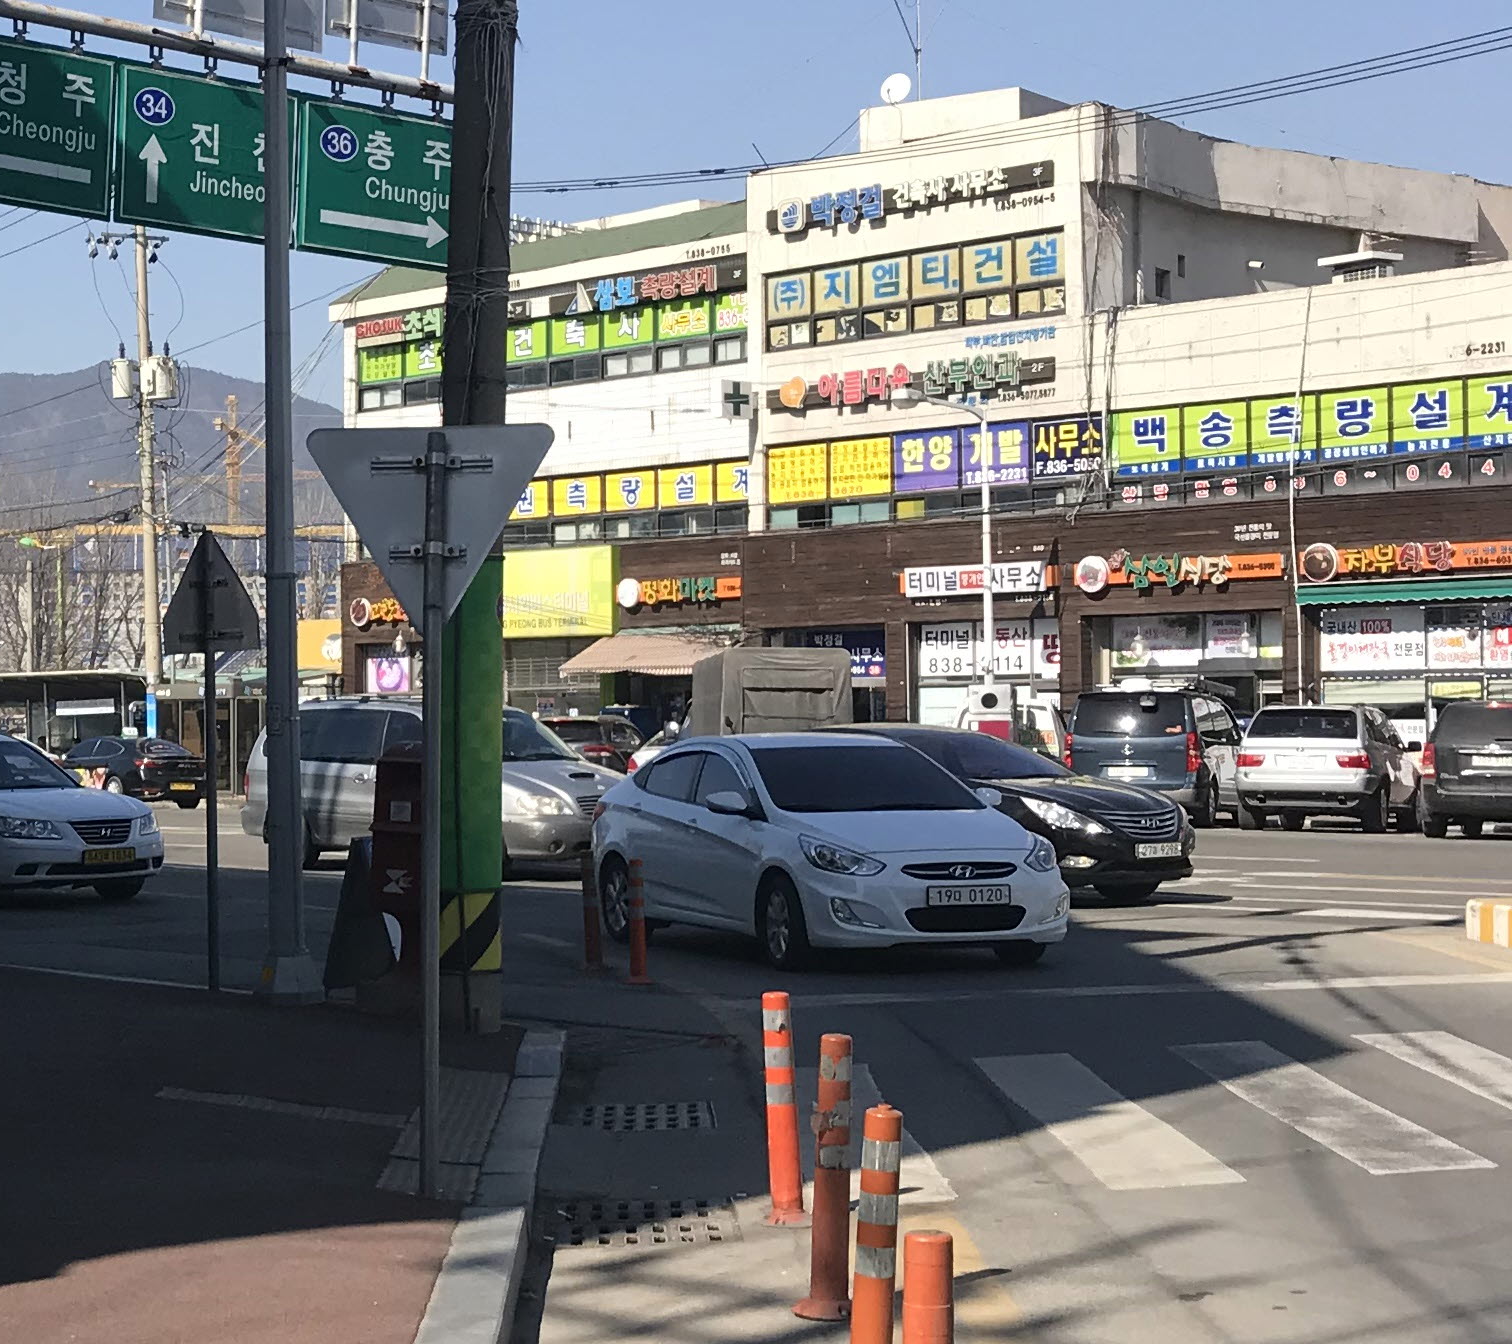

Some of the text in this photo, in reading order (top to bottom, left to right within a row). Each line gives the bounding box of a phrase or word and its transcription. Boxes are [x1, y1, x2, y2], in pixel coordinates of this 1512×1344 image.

[141, 93, 169, 118] 34
[327, 131, 353, 154] 36
[364, 130, 451, 181] 충주
[189, 170, 265, 205] Jincheo
[365, 177, 450, 212] Chungju
[892, 176, 946, 209] 건축사
[951, 166, 1008, 198] 사무소
[640, 265, 717, 301] 측량설계
[662, 309, 708, 336] 사무소
[923, 351, 1022, 395] 산부인과
[1031, 362, 1045, 373] 2F
[901, 434, 953, 473] 한양
[1035, 423, 1101, 459] 사무소
[908, 571, 957, 593] 터미널
[992, 566, 1041, 588] 사무소
[925, 629, 970, 650] 터미널
[1326, 620, 1391, 635] 국내산 100%
[1394, 642, 1424, 657] 전문점
[969, 888, 1003, 903] 0120
